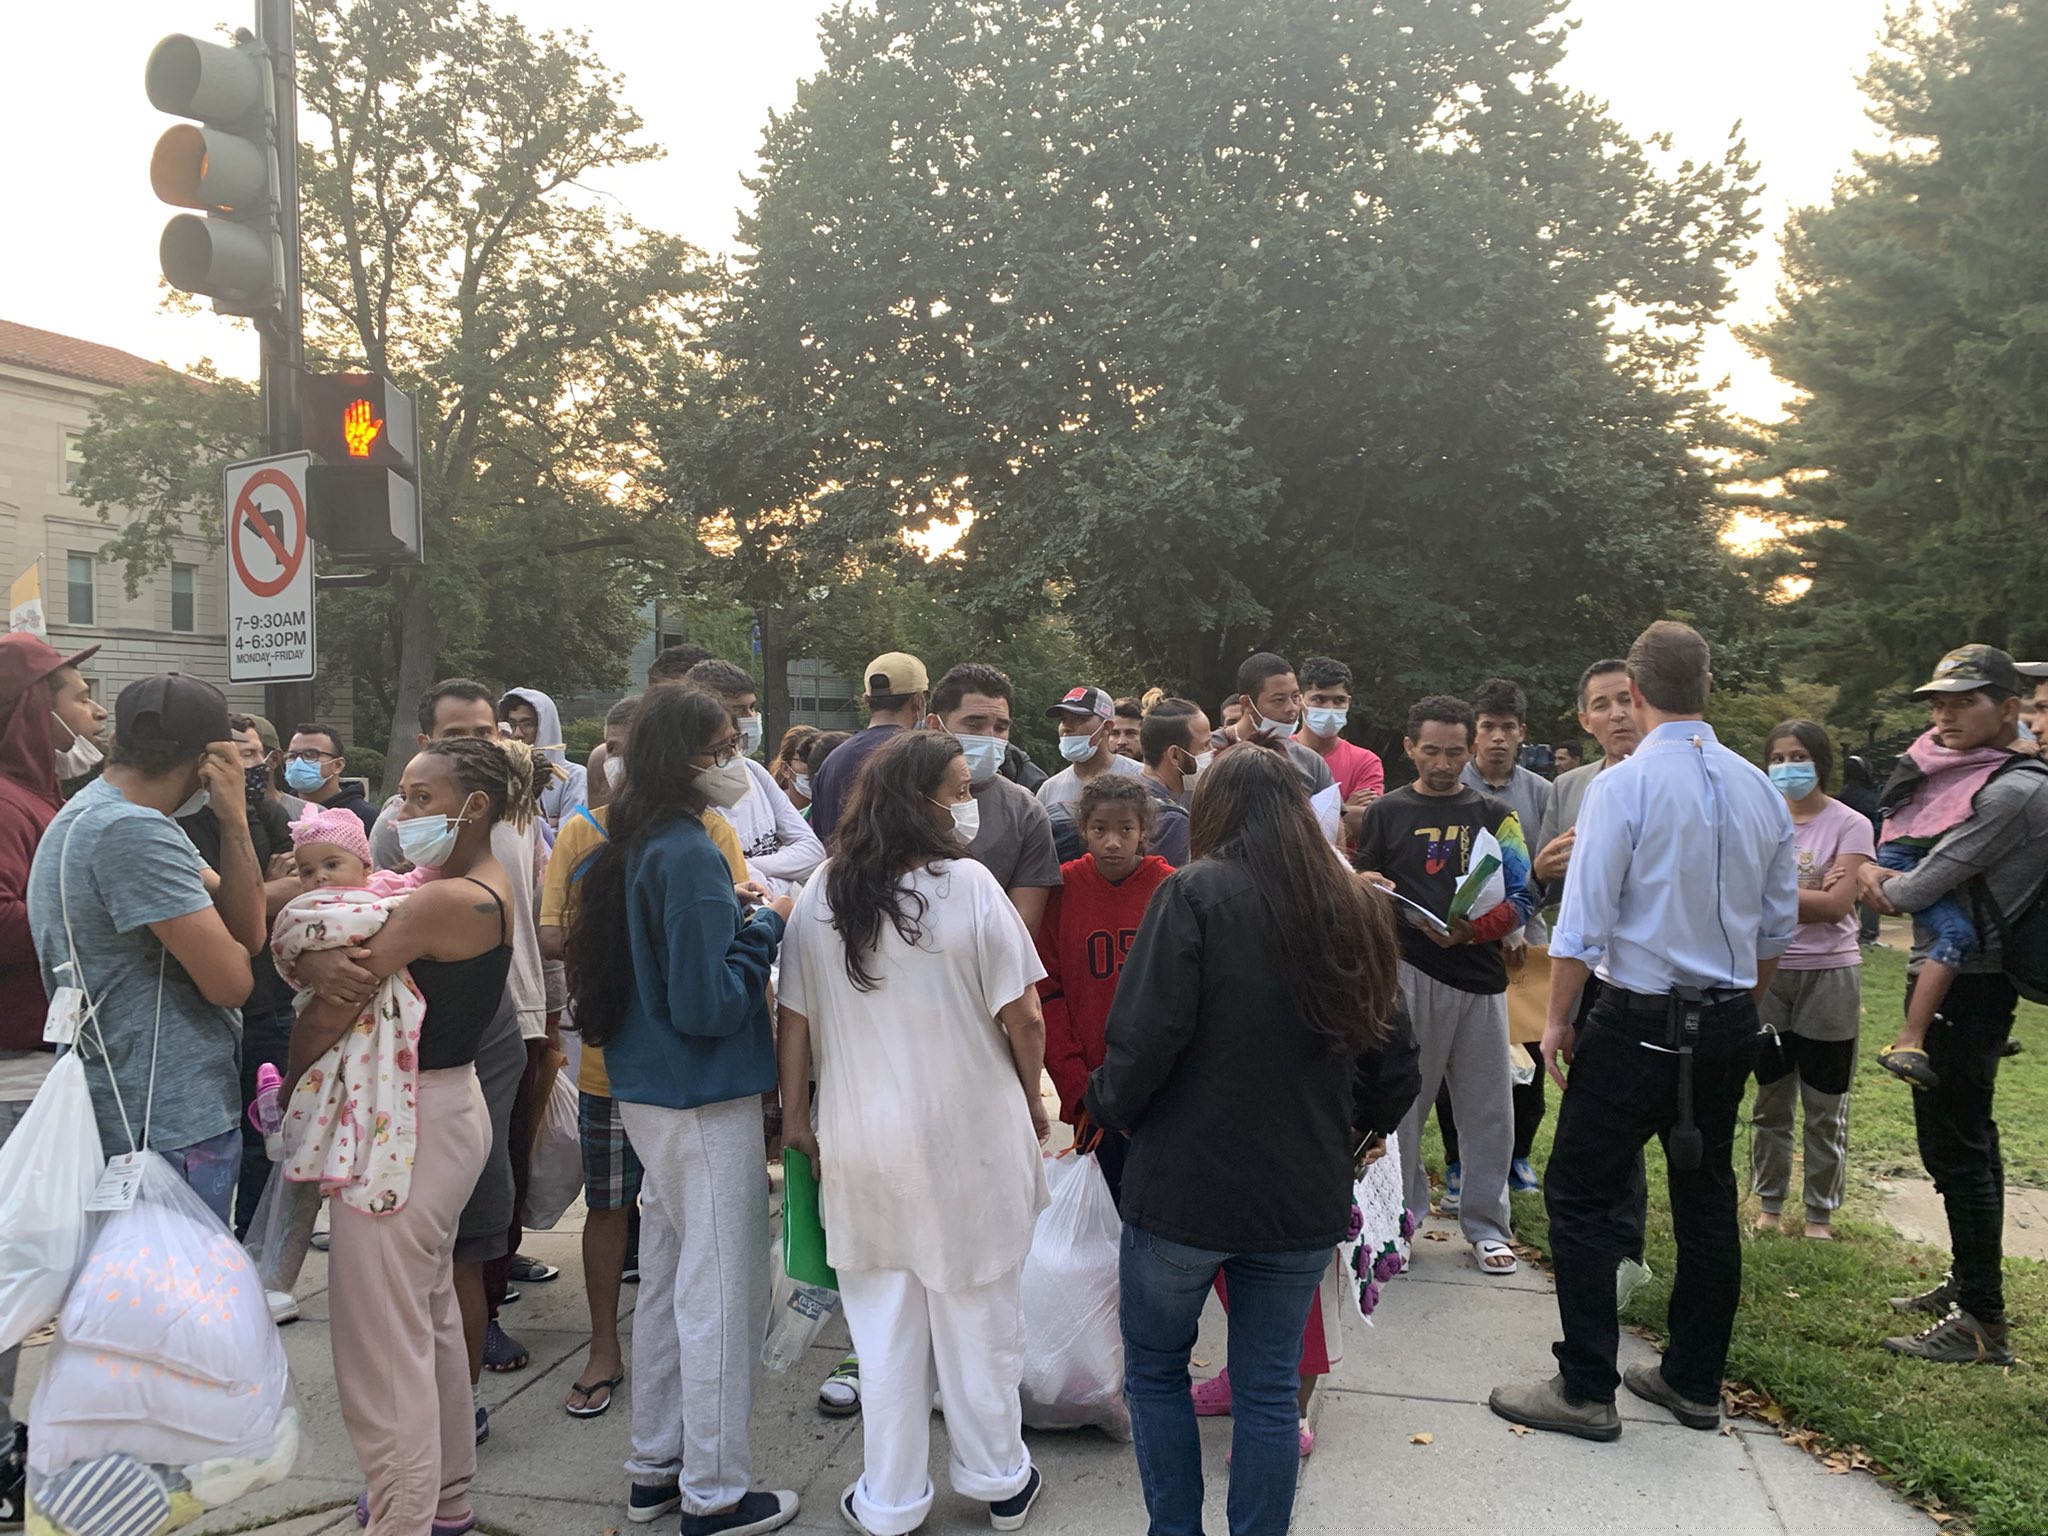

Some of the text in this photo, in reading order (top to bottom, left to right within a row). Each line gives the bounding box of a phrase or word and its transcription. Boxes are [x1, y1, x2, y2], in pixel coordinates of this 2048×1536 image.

[235, 610, 306, 631] 7-9:30AM
[235, 630, 306, 650] 4-6:30PM
[236, 649, 305, 664] MONDAY-FRIDAY
